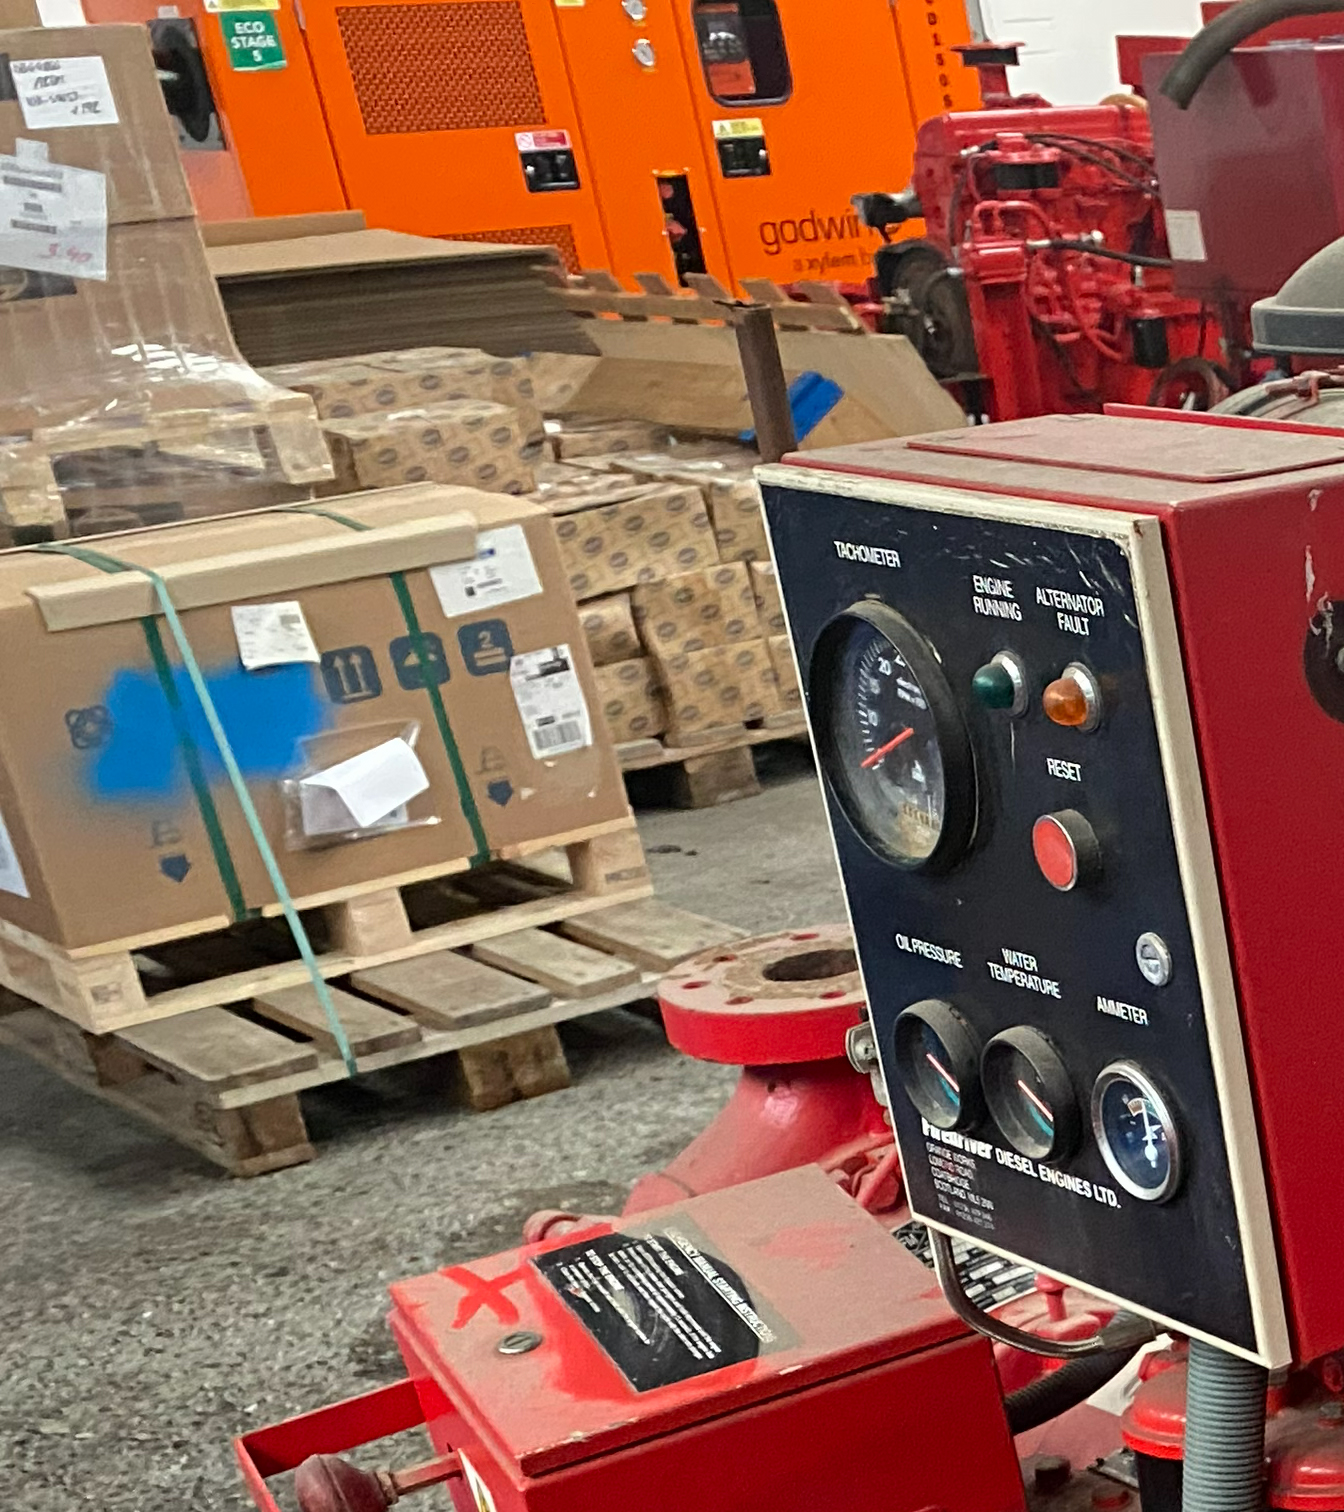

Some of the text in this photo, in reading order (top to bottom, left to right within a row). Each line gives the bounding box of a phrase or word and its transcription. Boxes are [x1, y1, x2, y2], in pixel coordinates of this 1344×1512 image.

[234, 20, 266, 34] ECO
[230, 34, 277, 49] STAGE
[252, 50, 263, 62] 5
[834, 541, 901, 568] TACHOMETER
[972, 574, 1015, 599] ENGINE
[972, 596, 1022, 622] RUNNING
[1035, 587, 1105, 618] ALTERNATOR
[1056, 612, 1090, 636] FAULT
[478, 631, 494, 649] 2
[1046, 758, 1082, 782] RESET
[895, 933, 964, 969] OIL PRESSURE
[1001, 947, 1038, 972] WATER
[987, 961, 1062, 999] TEMPERATURE
[1096, 996, 1149, 1026] AMMETER
[995, 1147, 1038, 1179] DIESEL
[1038, 1163, 1092, 1199] ENGINES
[1093, 1184, 1122, 1209] LTD.
